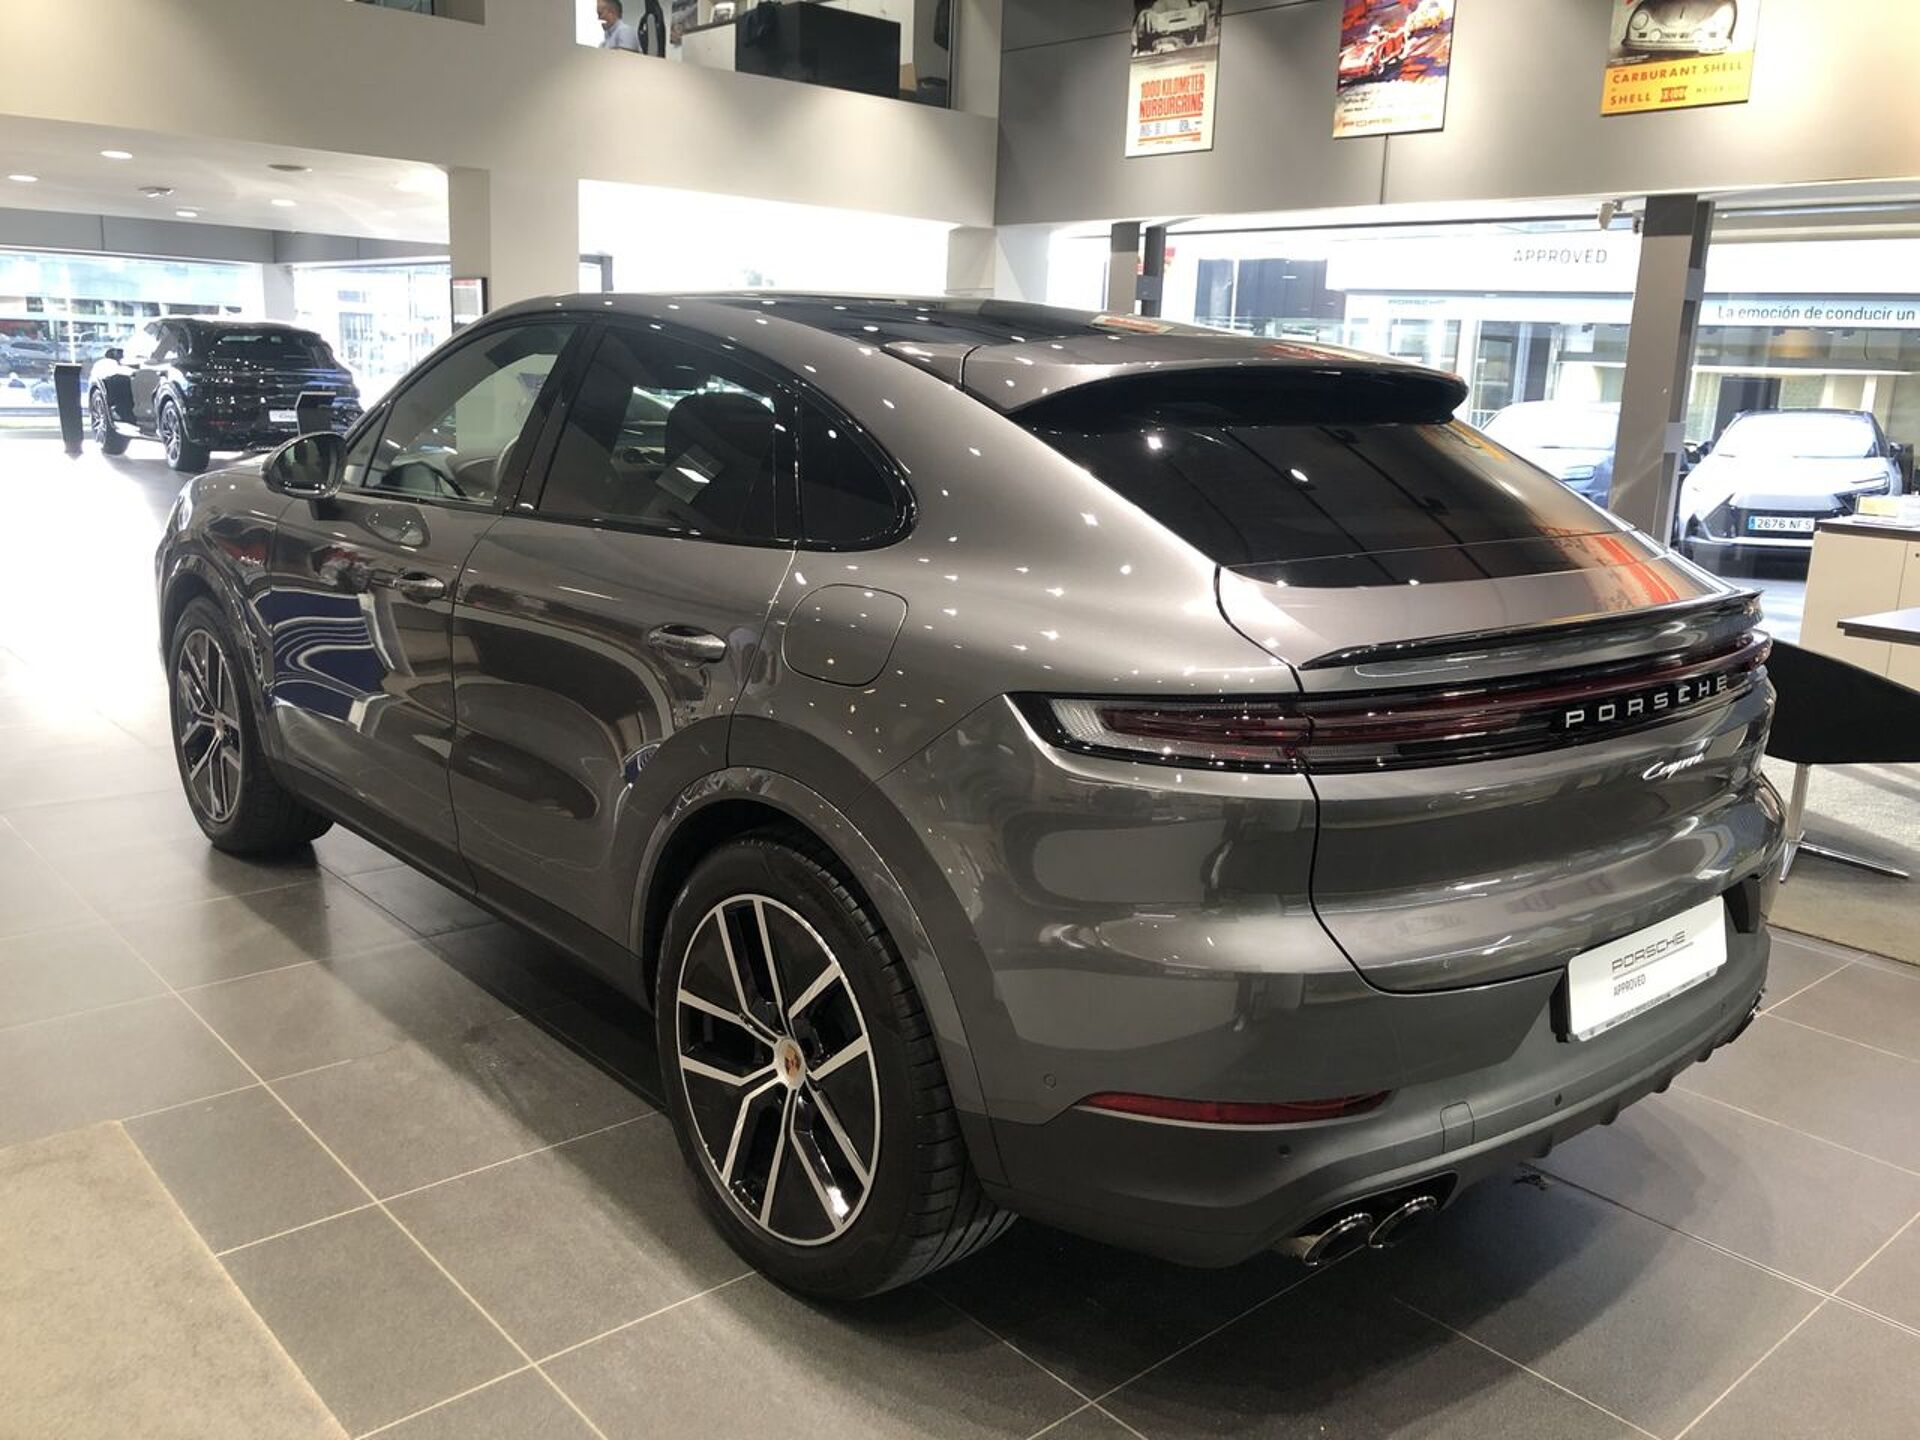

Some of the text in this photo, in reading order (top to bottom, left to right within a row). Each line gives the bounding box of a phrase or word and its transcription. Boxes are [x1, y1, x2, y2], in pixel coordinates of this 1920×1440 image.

[1612, 61, 1743, 84] CARBURANT SHELL
[1162, 73, 1204, 97] KILOMETER
[1610, 92, 1651, 106] SHELL
[1513, 248, 1608, 264] APPROVED
[1718, 304, 1916, 321] La emoción de conducir un
[1757, 518, 1786, 529] 2676
[1565, 674, 1729, 728] PORSCHE
[1611, 930, 1686, 973] PORSCHE
[1613, 973, 1646, 996] APPROVED
